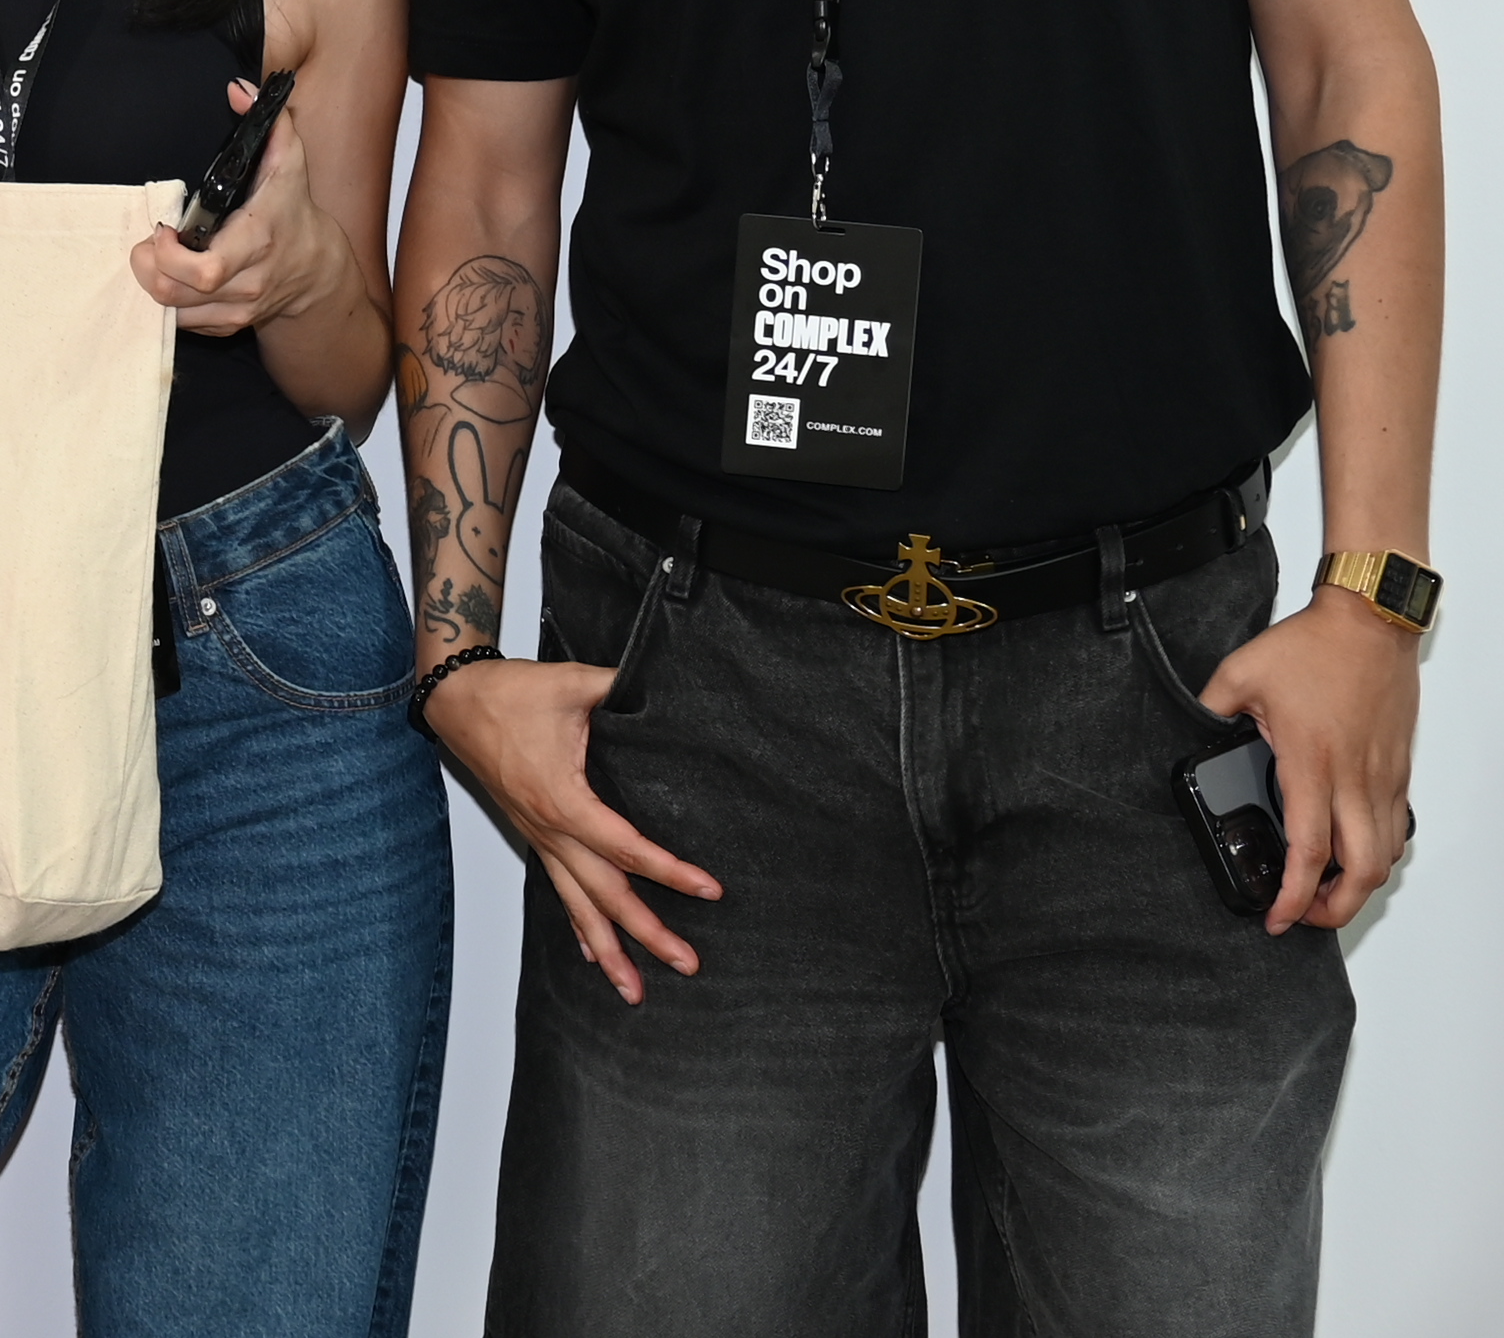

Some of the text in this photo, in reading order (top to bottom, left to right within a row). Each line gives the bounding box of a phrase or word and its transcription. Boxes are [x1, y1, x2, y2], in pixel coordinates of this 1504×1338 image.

[9, 69, 27, 97] on
[760, 247, 862, 294] Shop
[758, 283, 807, 311] on
[753, 311, 891, 357] COMPLEX
[751, 349, 839, 387] 24/7
[806, 421, 883, 437] COMPLEX.COM
